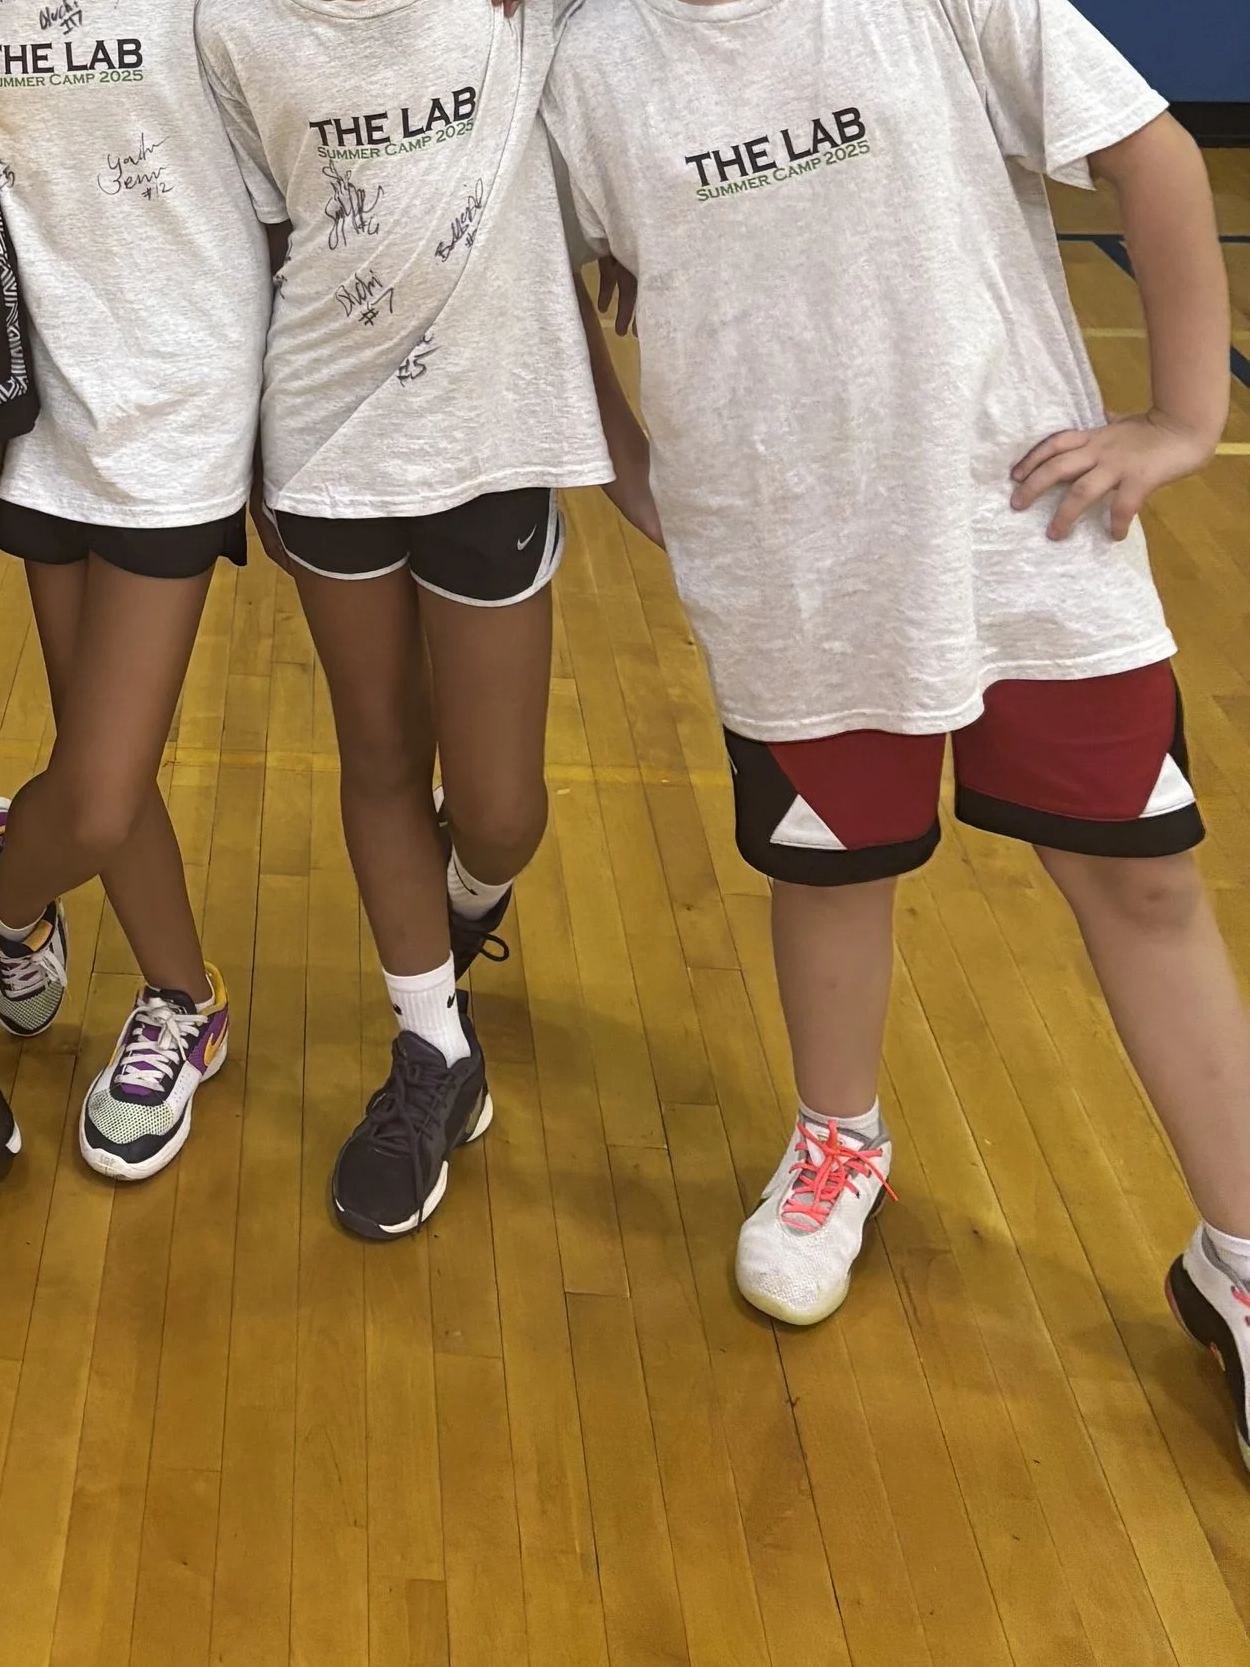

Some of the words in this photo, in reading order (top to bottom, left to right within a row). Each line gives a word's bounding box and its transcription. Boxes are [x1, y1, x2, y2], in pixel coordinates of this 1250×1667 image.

[49, 72, 95, 87] CAMP
[99, 69, 144, 83] 2025
[64, 37, 144, 72] LAB
[308, 110, 392, 147] THE
[400, 85, 477, 140] LAB
[317, 146, 381, 160] SUMMER
[384, 134, 433, 157] CAMP
[434, 118, 475, 143] 2025
[684, 134, 778, 188] THE
[779, 106, 867, 163] LAB
[696, 174, 772, 203] SUMMER
[772, 157, 823, 183] CAMP
[824, 139, 872, 166] 2025
